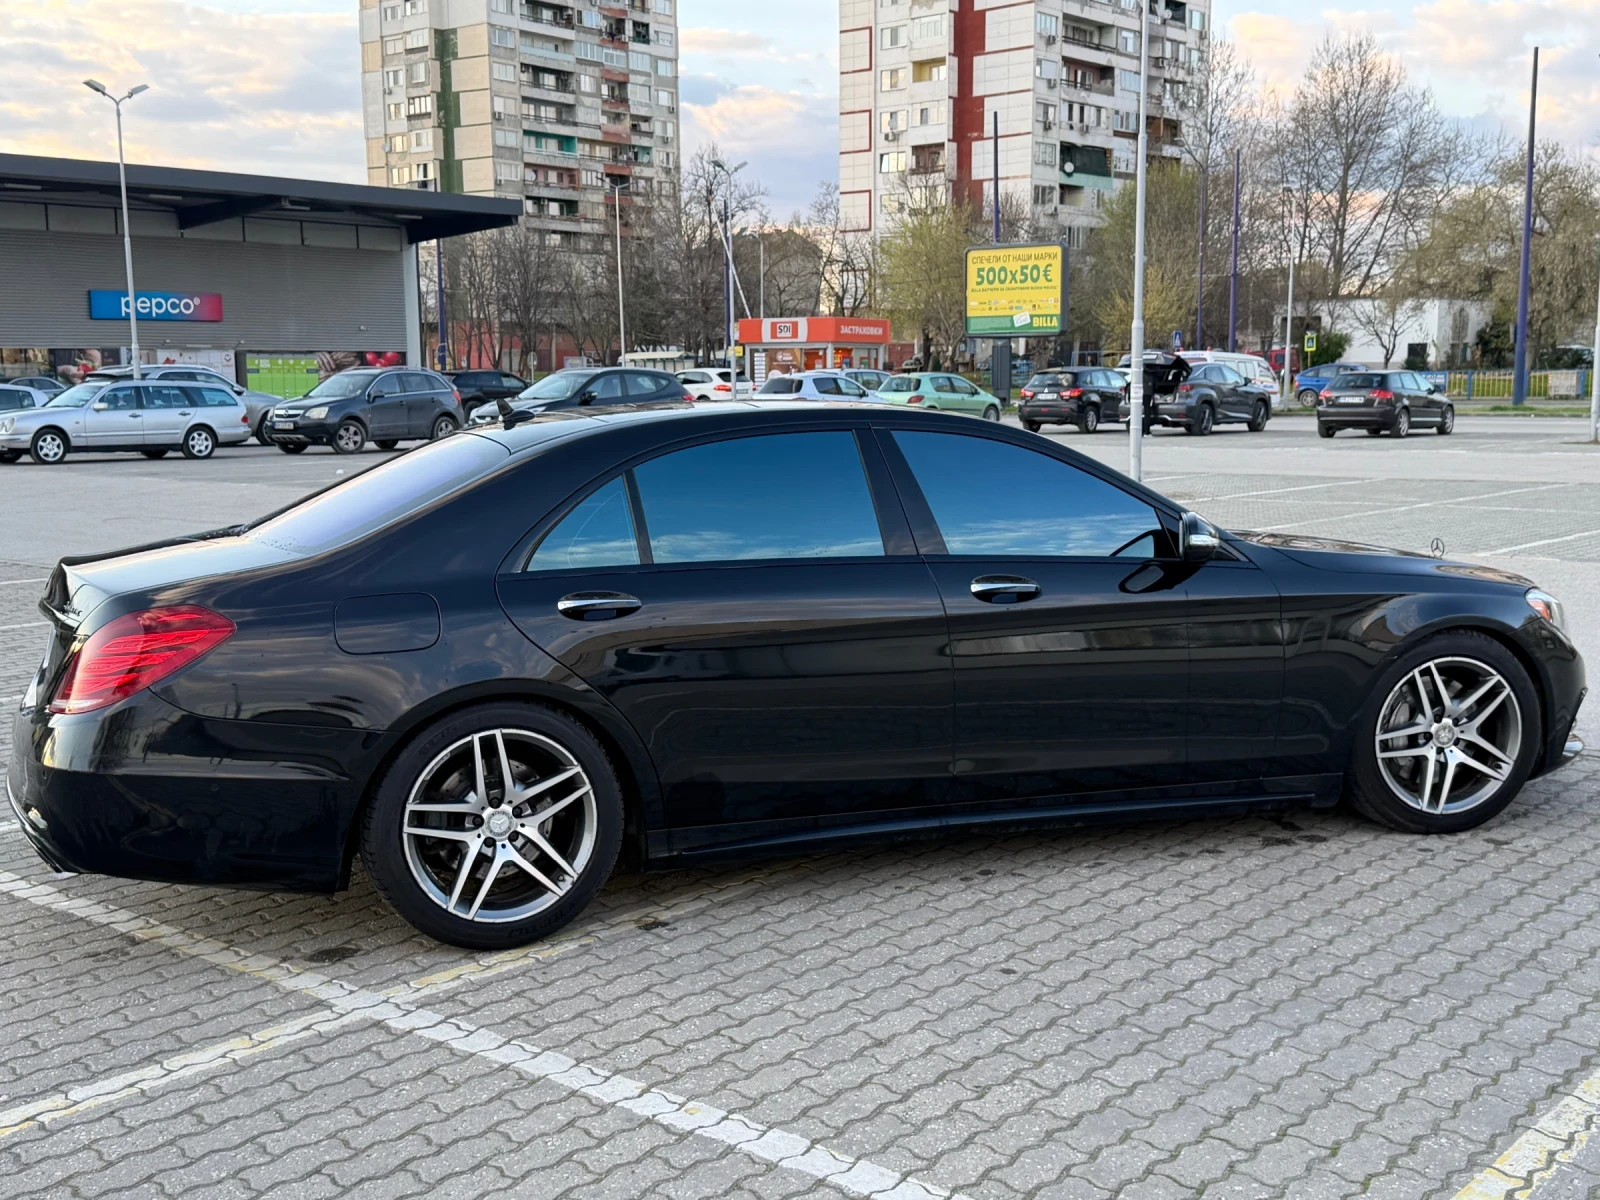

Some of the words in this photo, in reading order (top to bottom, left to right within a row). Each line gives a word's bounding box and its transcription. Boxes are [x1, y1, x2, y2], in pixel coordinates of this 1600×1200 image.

[972, 256, 1001, 264] СПЕЧЕЛИ
[1012, 254, 1032, 262] НАШИ
[1034, 252, 1058, 261] МАРКИ
[120, 296, 195, 318] pepco
[1032, 316, 1058, 327] BILLA
[778, 324, 791, 334] SDI
[840, 325, 883, 336] ЗАСТРАХОВКИ
